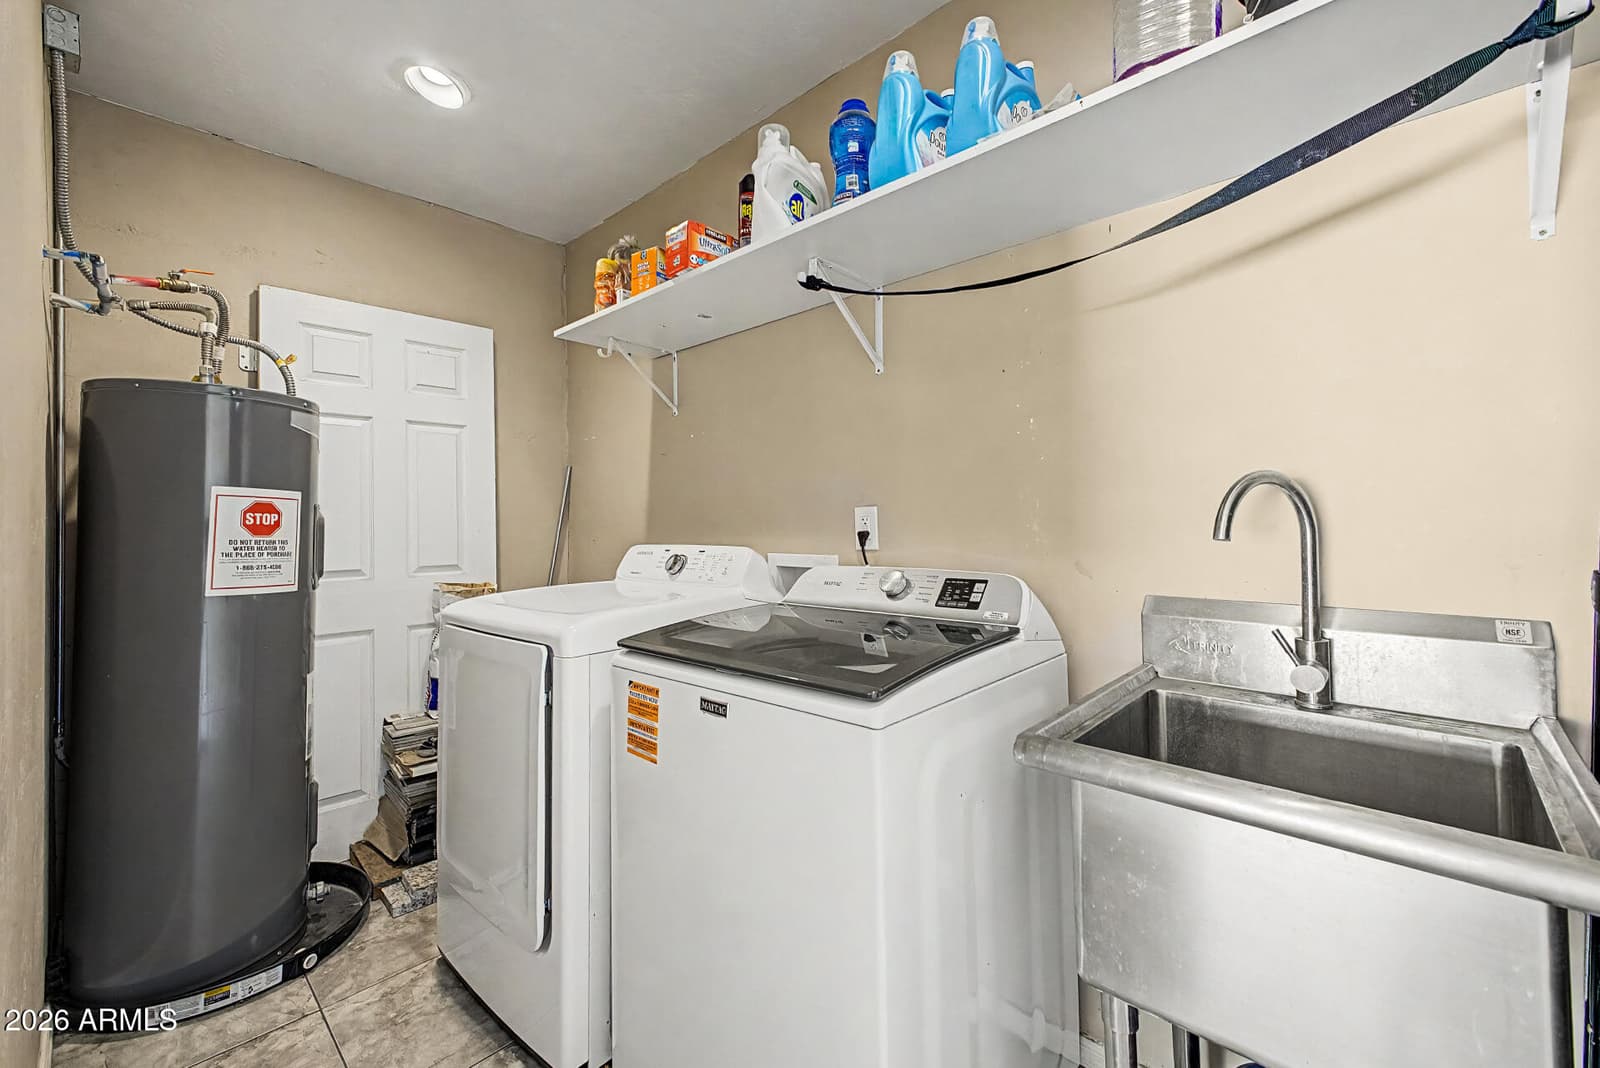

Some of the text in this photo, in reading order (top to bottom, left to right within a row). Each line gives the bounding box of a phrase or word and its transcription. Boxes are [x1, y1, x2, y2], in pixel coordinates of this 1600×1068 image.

[742, 203, 752, 219] Ra
[790, 200, 803, 218] all
[246, 512, 278, 526] STOP
[701, 700, 727, 715] MAYTAG
